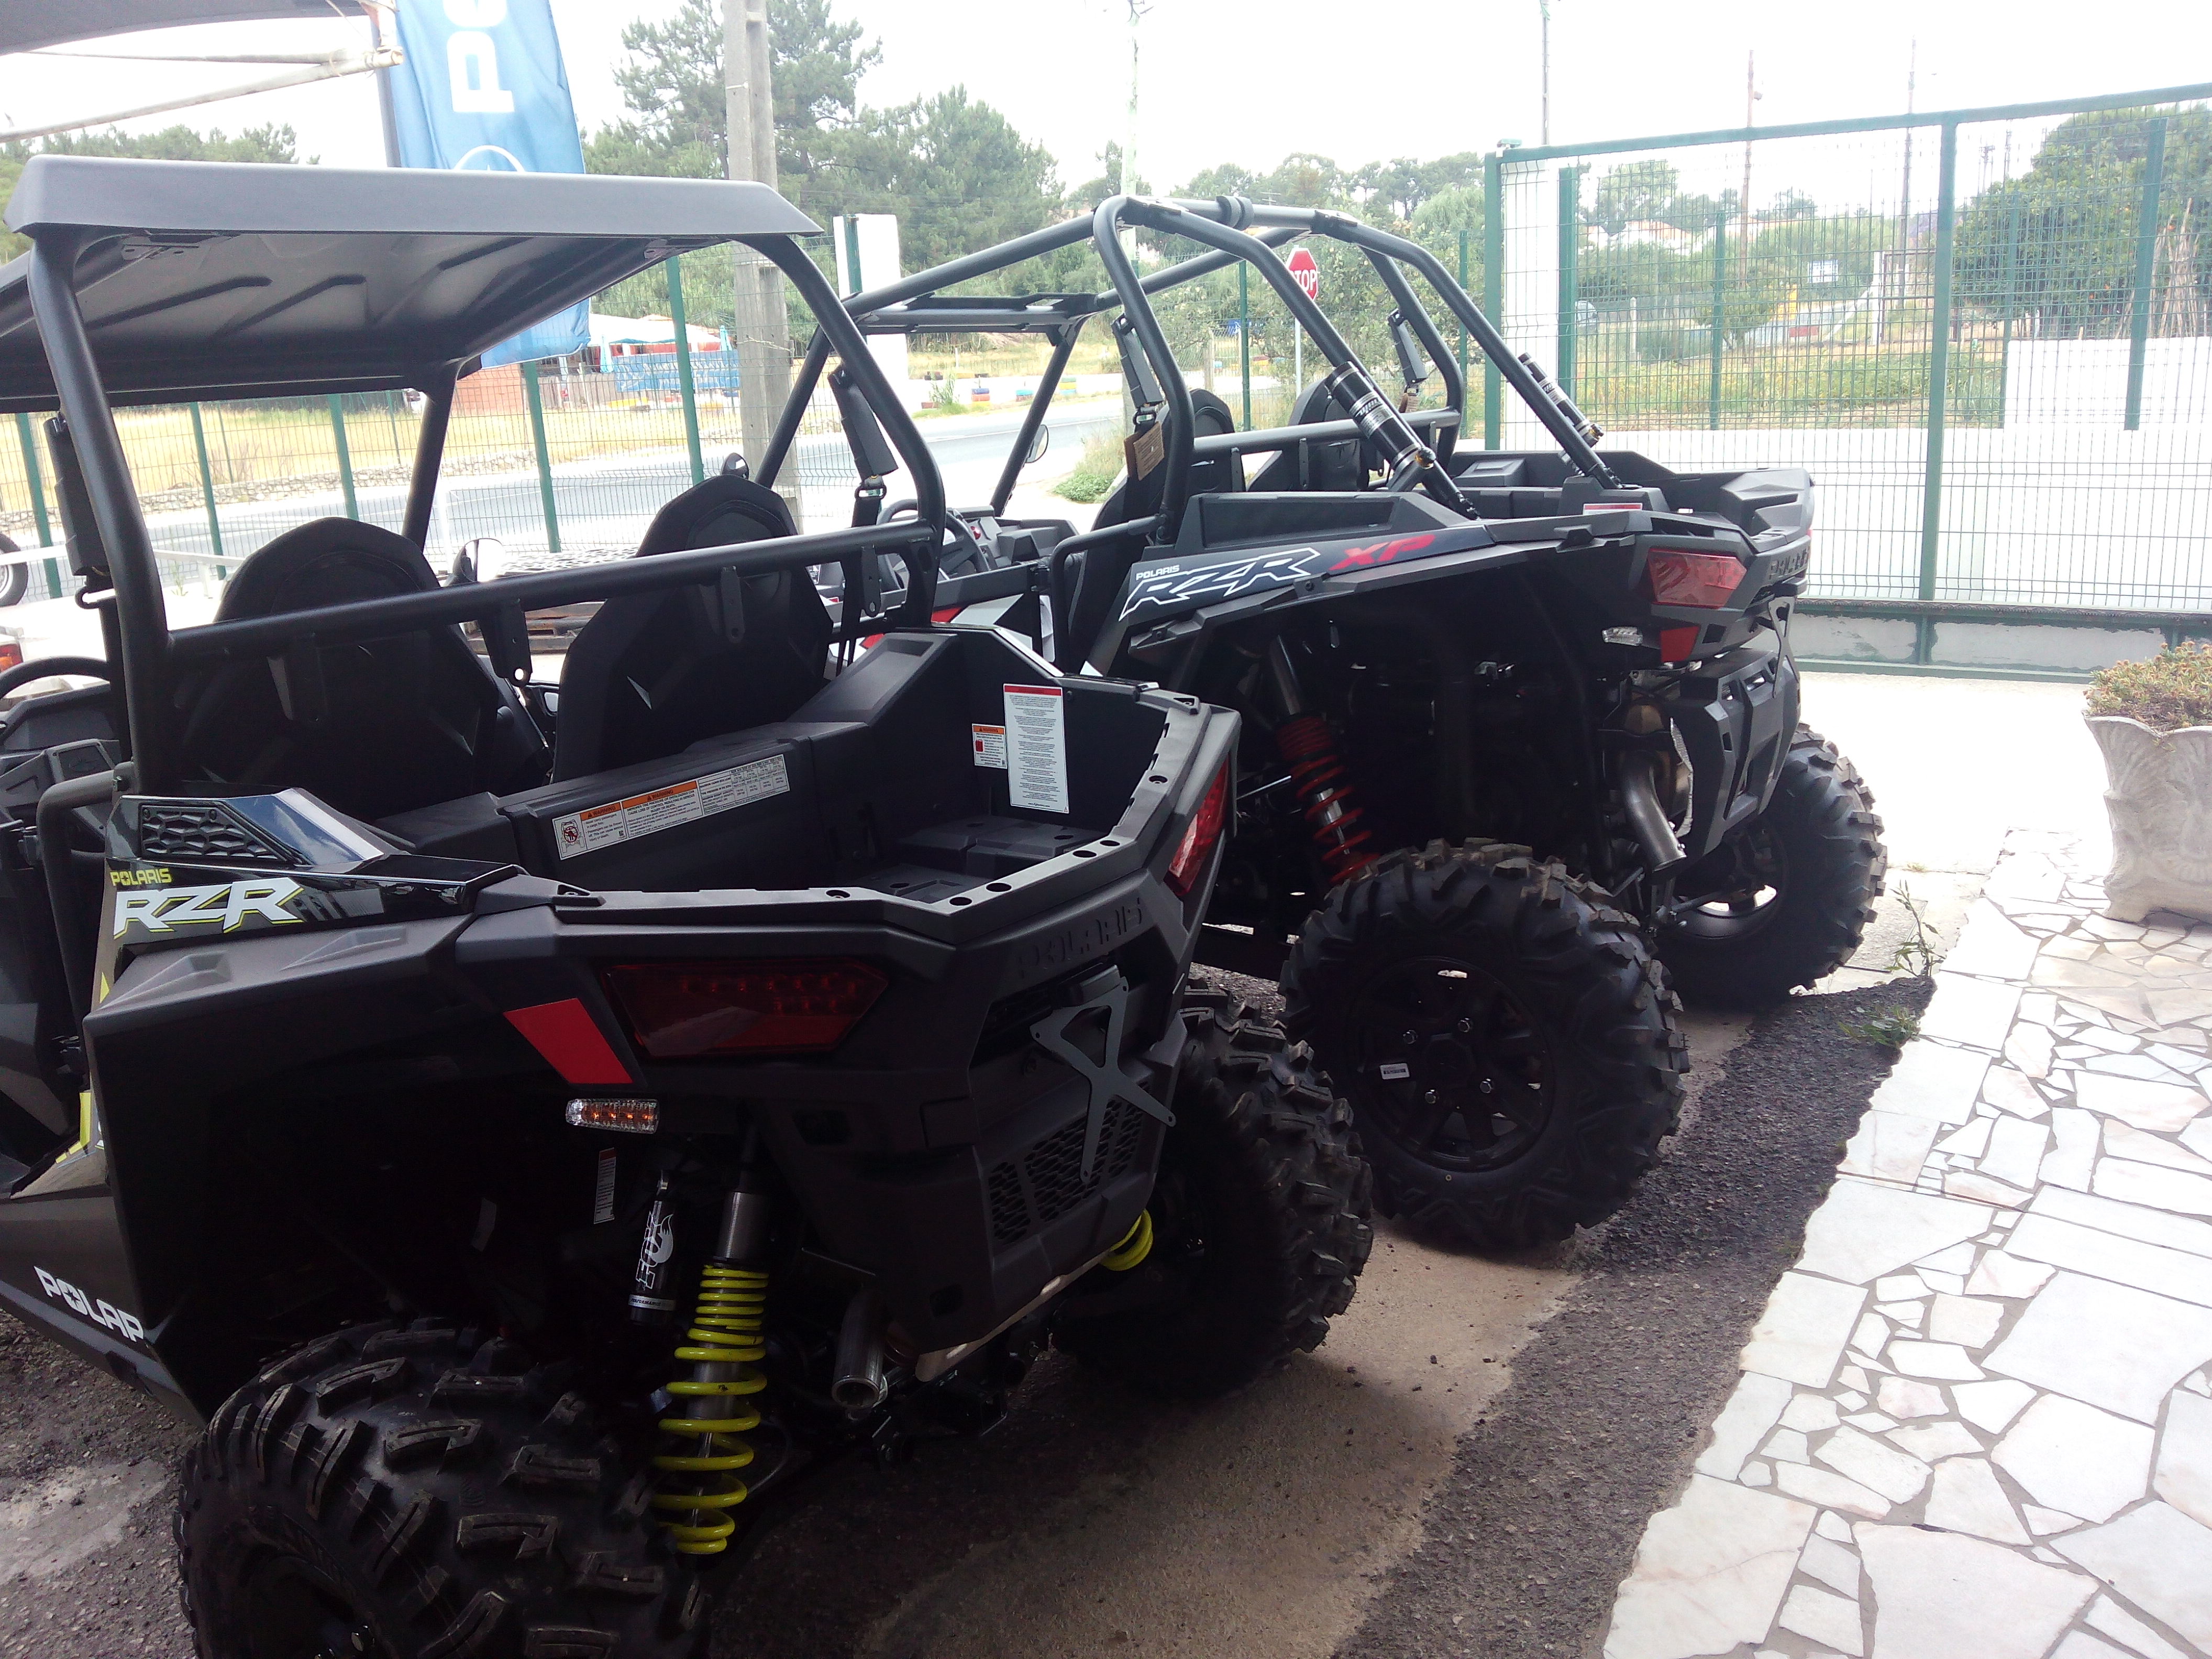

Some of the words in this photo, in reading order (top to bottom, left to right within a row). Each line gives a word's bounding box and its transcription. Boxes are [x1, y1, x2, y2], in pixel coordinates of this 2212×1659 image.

[1289, 269, 1316, 291] TOP
[1119, 547, 1321, 622] RZR
[1329, 534, 1435, 570] XP
[1135, 565, 1180, 581] POLARIS
[652, 789, 674, 799] WARNING
[593, 806, 616, 816] WARNING
[110, 868, 172, 886] POLARIS
[114, 877, 304, 939] RZR
[1017, 897, 1143, 979] POLARIS
